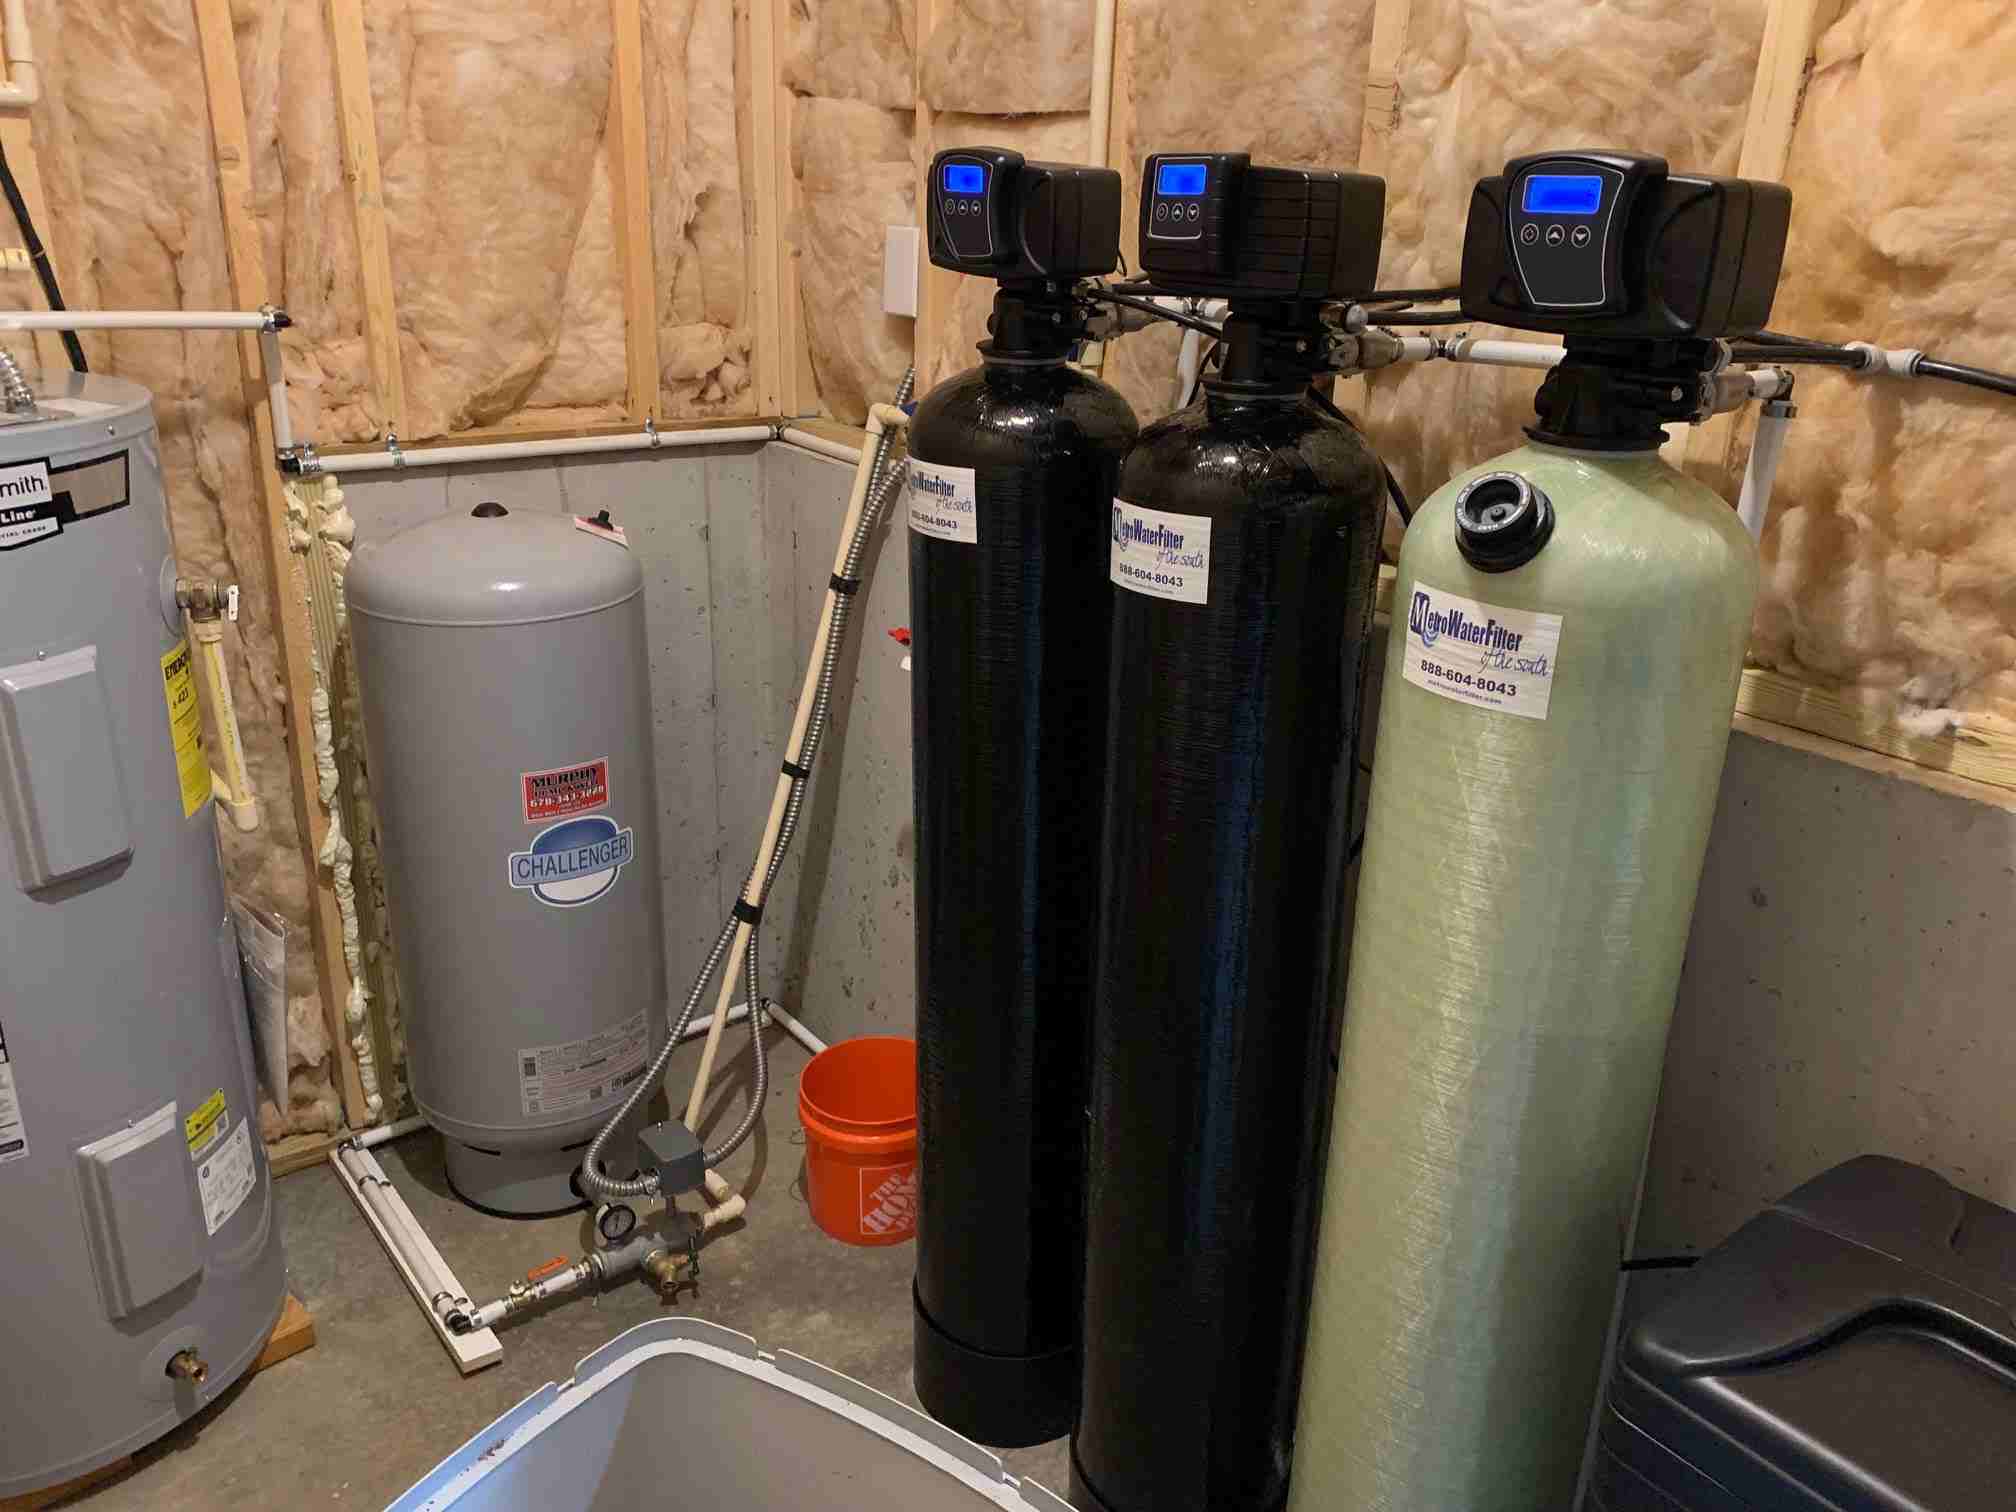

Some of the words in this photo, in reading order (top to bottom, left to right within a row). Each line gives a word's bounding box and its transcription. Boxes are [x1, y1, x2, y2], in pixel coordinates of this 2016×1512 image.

[1120, 563, 1184, 587] 888-604-8043
[1409, 591, 1523, 652] MetroWaterFilter
[1420, 659, 1517, 697] 888-604-8043
[517, 836, 629, 880] CHALLENGER
